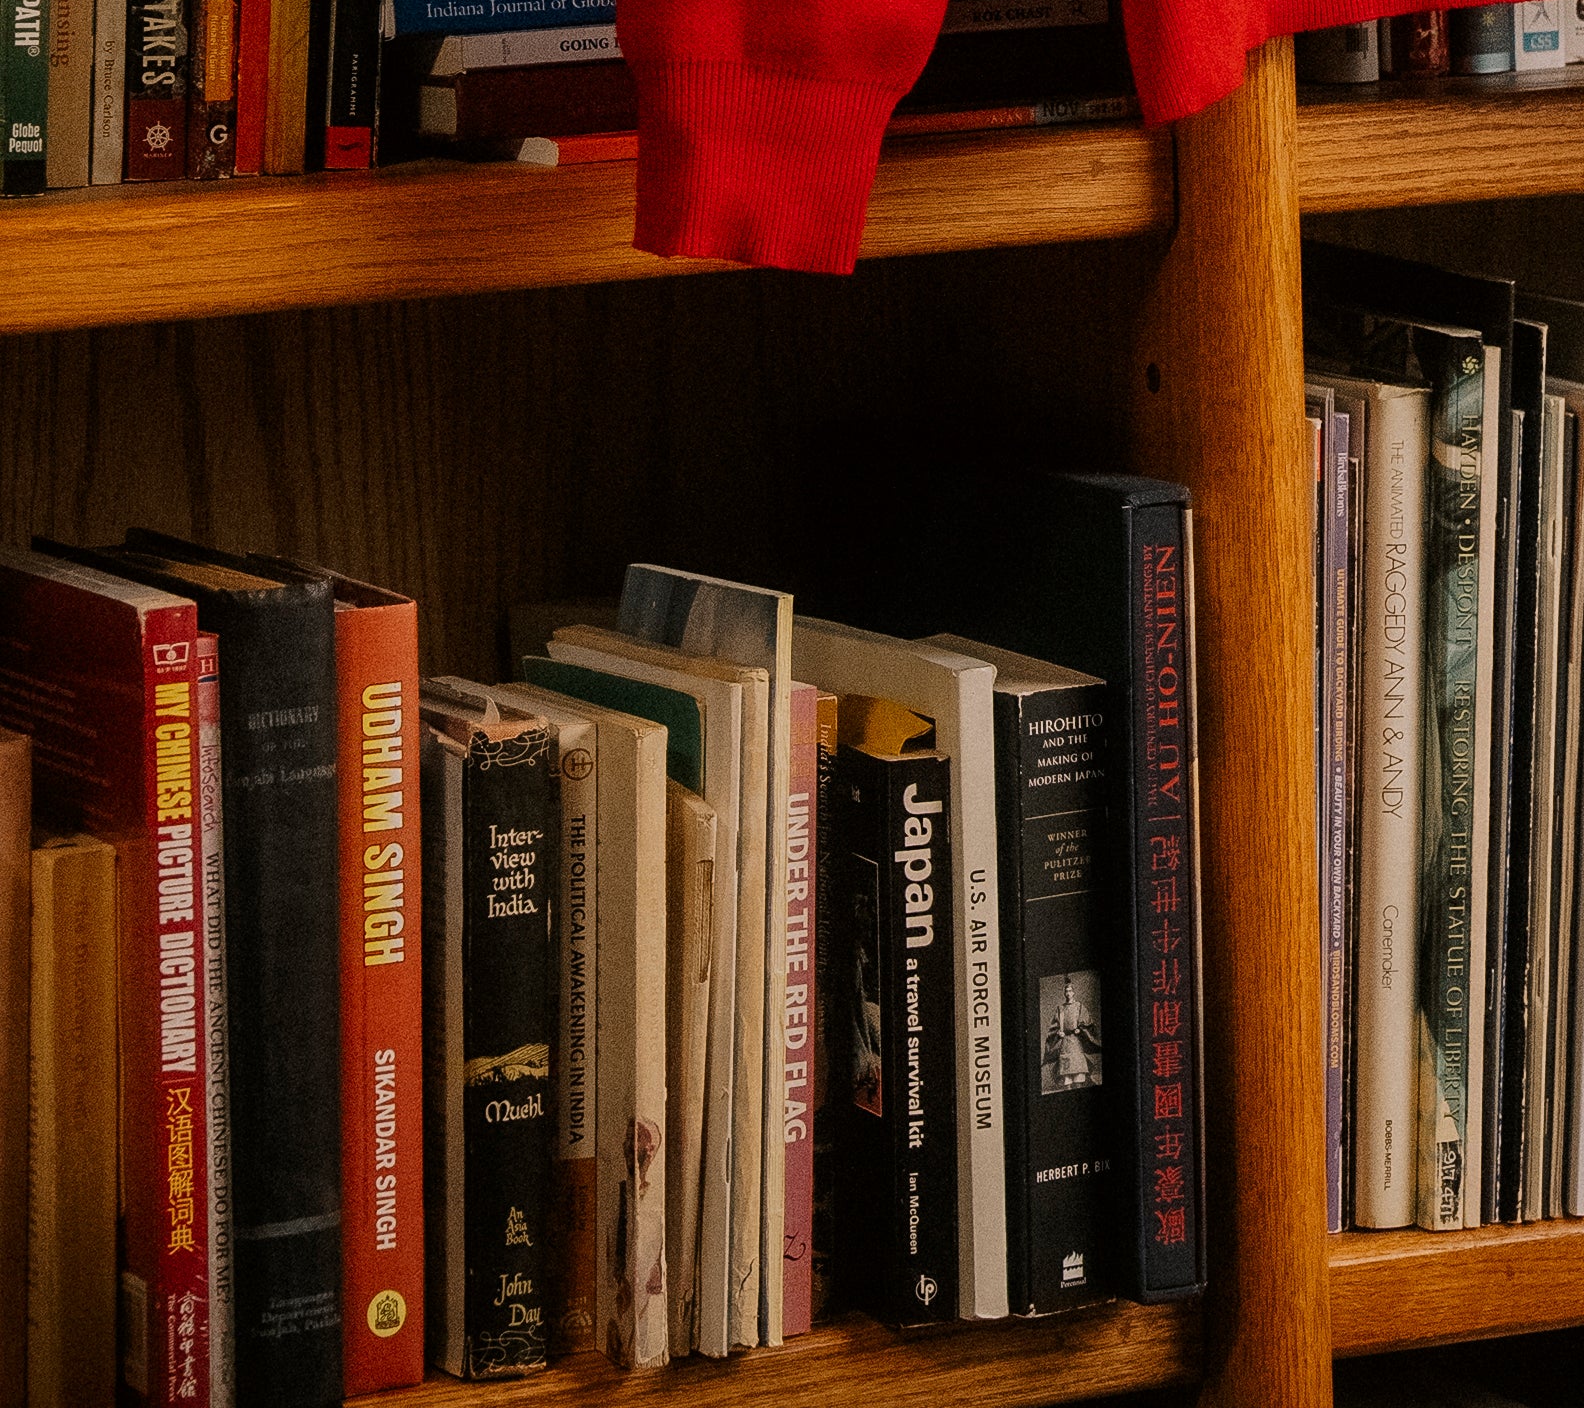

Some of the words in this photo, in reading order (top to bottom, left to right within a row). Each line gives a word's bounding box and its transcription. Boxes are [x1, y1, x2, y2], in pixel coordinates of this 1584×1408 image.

[141, 1, 177, 86] TAKES
[1382, 541, 1408, 653] RAGGEDY
[154, 682, 188, 718] MY
[1382, 658, 1408, 720] ANN
[361, 681, 405, 831] UDHAM
[1382, 726, 1407, 747] &
[155, 724, 192, 820] CHINESE
[1380, 751, 1404, 819] ANDY
[492, 852, 538, 870] view
[568, 815, 588, 849] THE
[785, 793, 811, 903] UNDER
[157, 824, 194, 923] PICTURE
[493, 875, 532, 891] with
[568, 855, 588, 941] POLITICAL
[894, 783, 945, 949] Japan
[970, 869, 988, 911] U.S.
[364, 844, 405, 967] SINGH
[487, 894, 539, 918] India
[971, 919, 988, 955] AIR
[785, 911, 809, 971] THE
[905, 958, 917, 971] a
[160, 934, 197, 1072] DICTIONARY
[568, 947, 588, 1061] AWAKENING
[784, 984, 808, 1051] RED
[906, 977, 922, 1032] travel
[972, 962, 989, 1026] FORCE
[372, 1050, 397, 1168] SIKANDAR
[568, 1066, 588, 1085] IN
[782, 1062, 808, 1143] FLAG
[906, 1037, 923, 1114] survival
[975, 1036, 992, 1131] MUSEUM
[568, 1091, 588, 1144] INDIA
[907, 1121, 924, 1149] kit
[164, 1088, 198, 1254] 汉语图解词典
[910, 1172, 920, 1191] Ian
[375, 1174, 397, 1251] SINGH
[907, 1195, 921, 1254] McQueen
